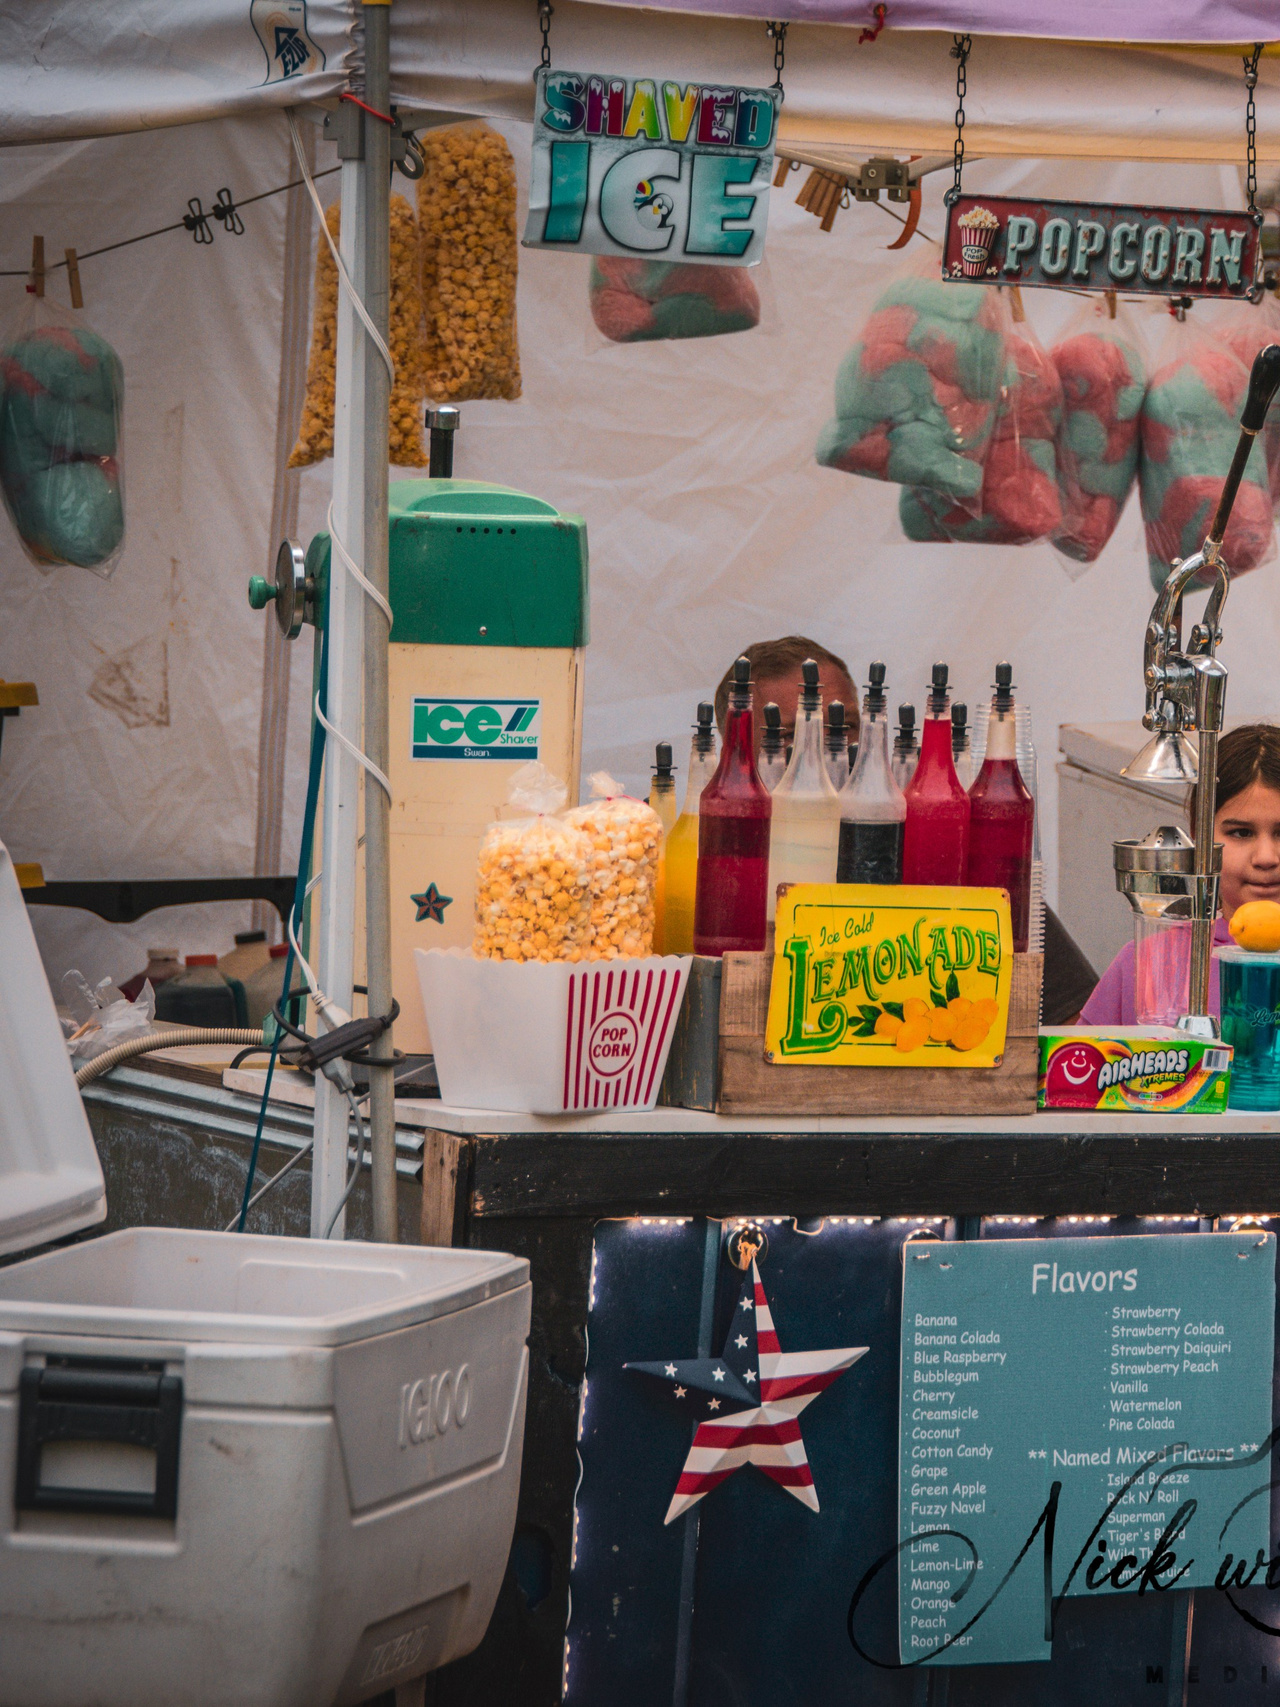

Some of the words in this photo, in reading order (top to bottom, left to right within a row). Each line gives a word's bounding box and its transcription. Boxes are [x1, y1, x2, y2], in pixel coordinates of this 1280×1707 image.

[543, 71, 776, 149] SHAVED
[542, 141, 761, 256] ICE
[1001, 214, 1248, 289] POPCORN
[500, 732, 539, 745] Shaver
[463, 747, 491, 757] Swan
[819, 925, 840, 948] Ice
[844, 911, 875, 939] Cold
[780, 916, 1002, 1056] LEMONADE
[601, 1027, 628, 1042] POP
[592, 1043, 631, 1058] CORN
[1096, 1048, 1191, 1091] AIRHEADS
[1139, 1072, 1187, 1089] XTREMES
[1031, 1261, 1138, 1295] Flavors
[914, 1313, 958, 1327] Banana
[1111, 1305, 1181, 1321] Strawberry
[914, 1332, 957, 1346] Banana
[960, 1330, 1000, 1345] Colada
[1111, 1324, 1181, 1339] Strawberry
[1184, 1321, 1225, 1336] Colada
[1110, 1342, 1180, 1358] Strawberry
[1183, 1340, 1232, 1357] Daiquiri
[913, 1351, 940, 1364] Blue
[943, 1349, 1007, 1367] Raspberry
[1110, 1361, 1180, 1376] Strawberry
[1182, 1359, 1219, 1373] Peach
[913, 1369, 980, 1386] Bubblegum
[1110, 1379, 1149, 1394] Vanilla
[912, 1388, 956, 1405] Cherry
[1109, 1397, 1182, 1413] Watermelon
[911, 1406, 980, 1421] Creamsicle
[1109, 1417, 1134, 1431] Pine
[1136, 1416, 1175, 1431] Colada
[911, 1426, 962, 1439] Coconut
[911, 1445, 954, 1459] Cotton
[956, 1443, 994, 1460] Candy
[1052, 1446, 1111, 1468] Named
[1116, 1444, 1168, 1465] Mixed
[1172, 1443, 1235, 1463] Flavors
[911, 1463, 948, 1481] Grape
[911, 1482, 949, 1497] Green
[952, 1480, 987, 1498] Apple
[1157, 1489, 1179, 1503] Roll
[911, 1501, 947, 1518] Fuzzy
[952, 1499, 986, 1514] Navel
[1107, 1511, 1166, 1527] Superman
[911, 1520, 951, 1535] Lemon
[1107, 1528, 1150, 1546] Tiger's
[911, 1540, 940, 1553] Lime
[911, 1558, 984, 1572] Lemon-Lime
[911, 1578, 950, 1594] Mango
[911, 1597, 957, 1613] Orange
[911, 1615, 947, 1629] Peach
[911, 1634, 940, 1647] Root
